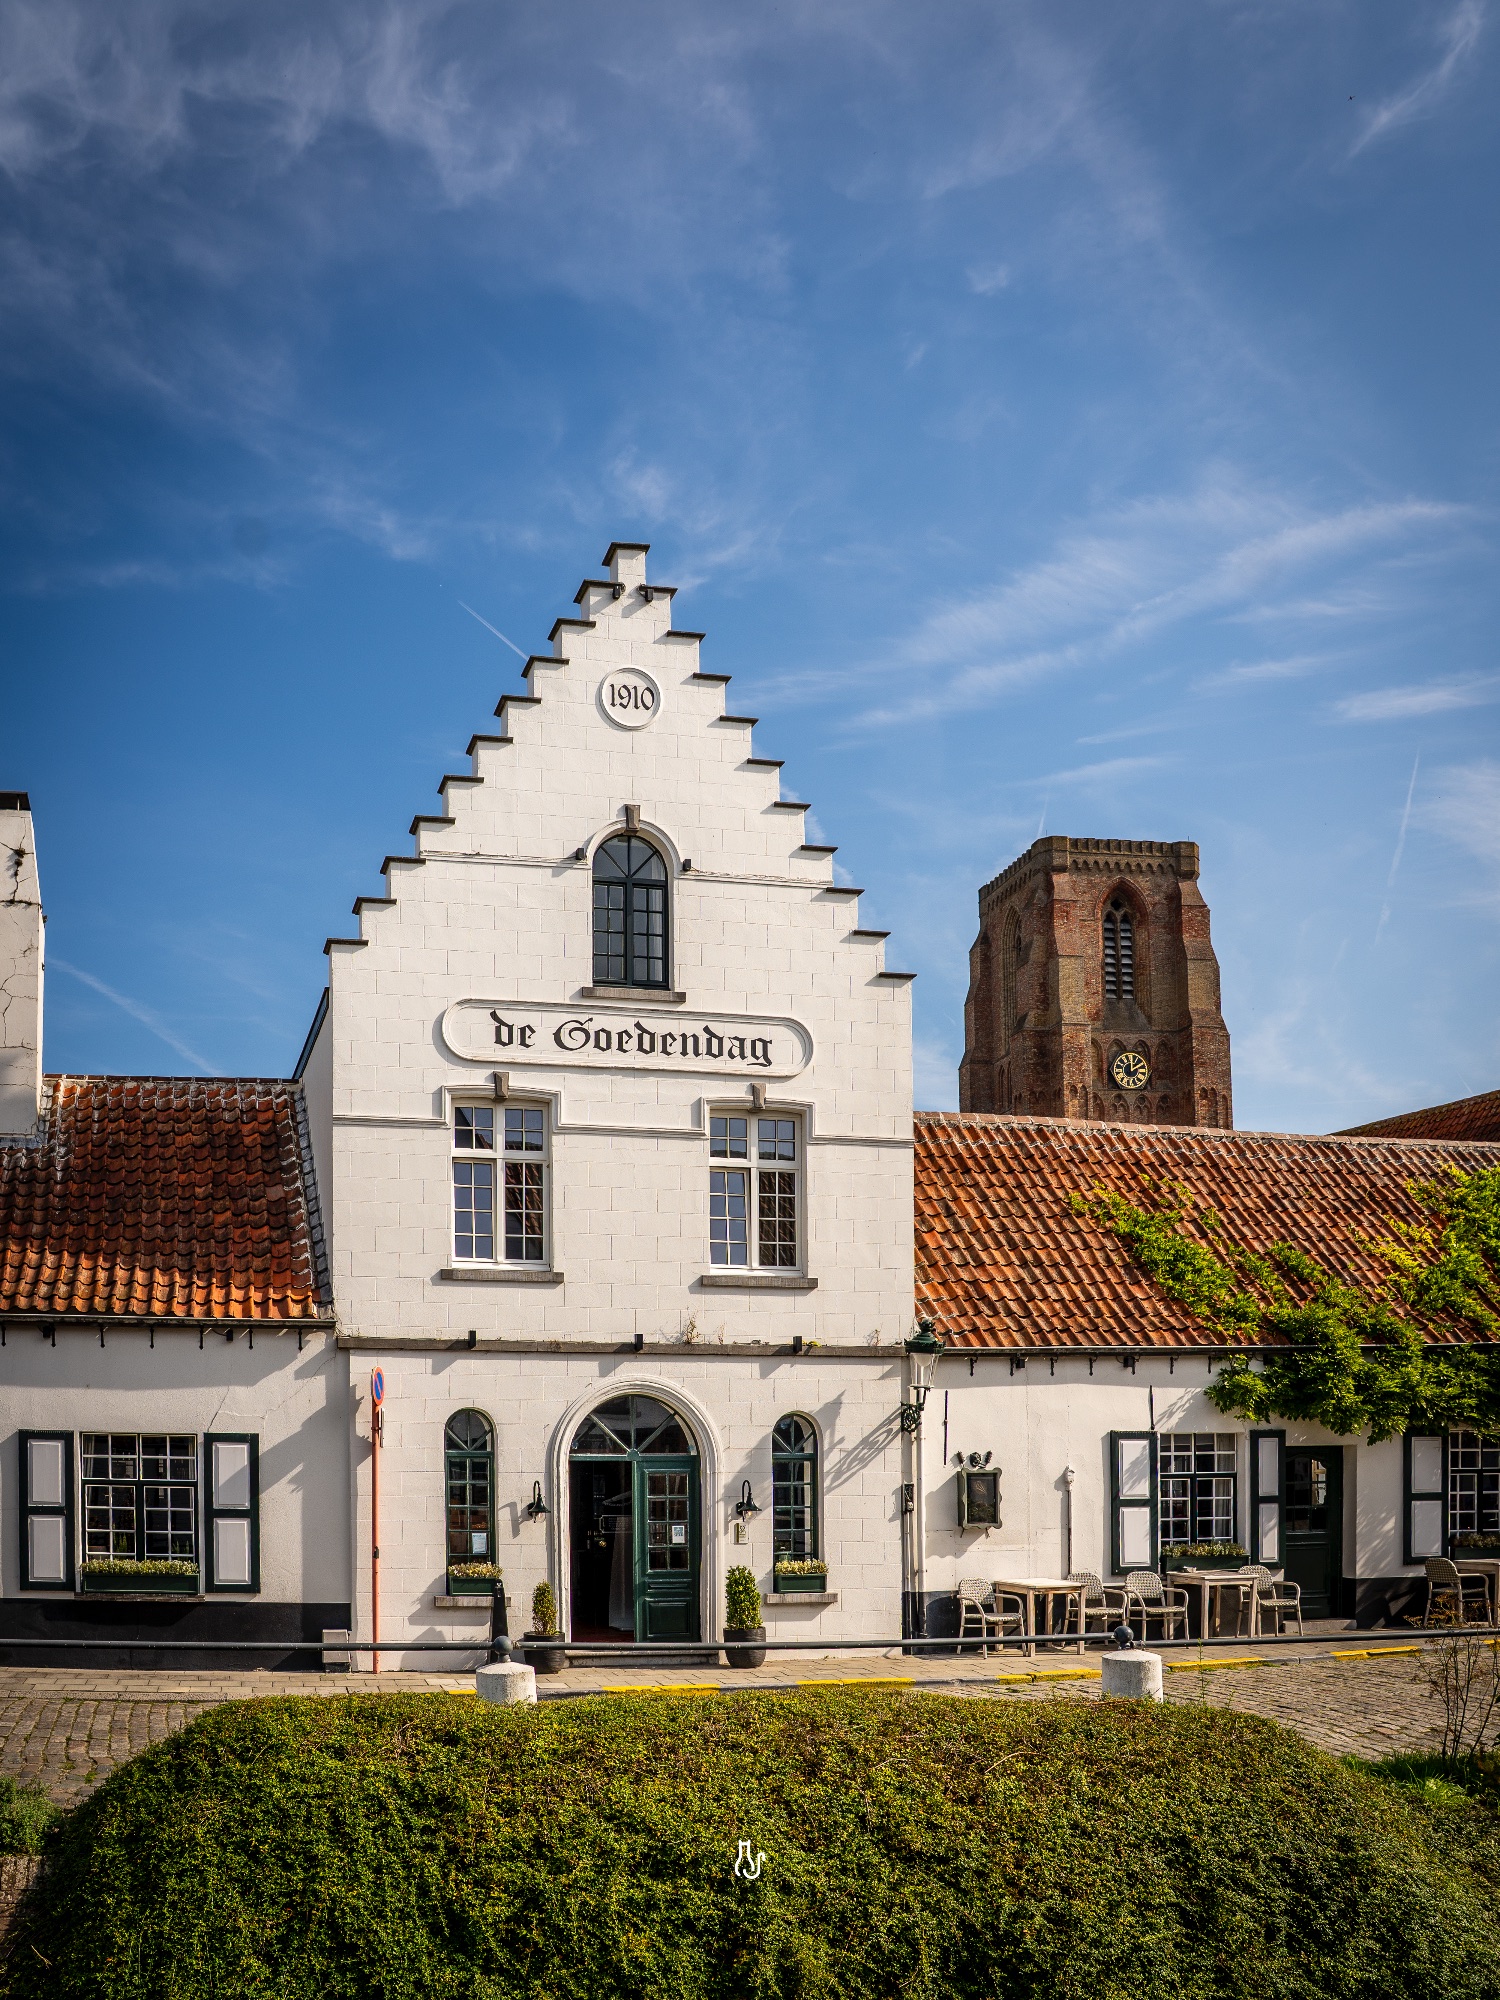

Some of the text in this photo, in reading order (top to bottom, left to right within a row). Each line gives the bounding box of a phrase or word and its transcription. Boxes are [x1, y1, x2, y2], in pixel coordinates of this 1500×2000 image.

[609, 683, 655, 711] 1910
[489, 1009, 773, 1068] de Goedendag
